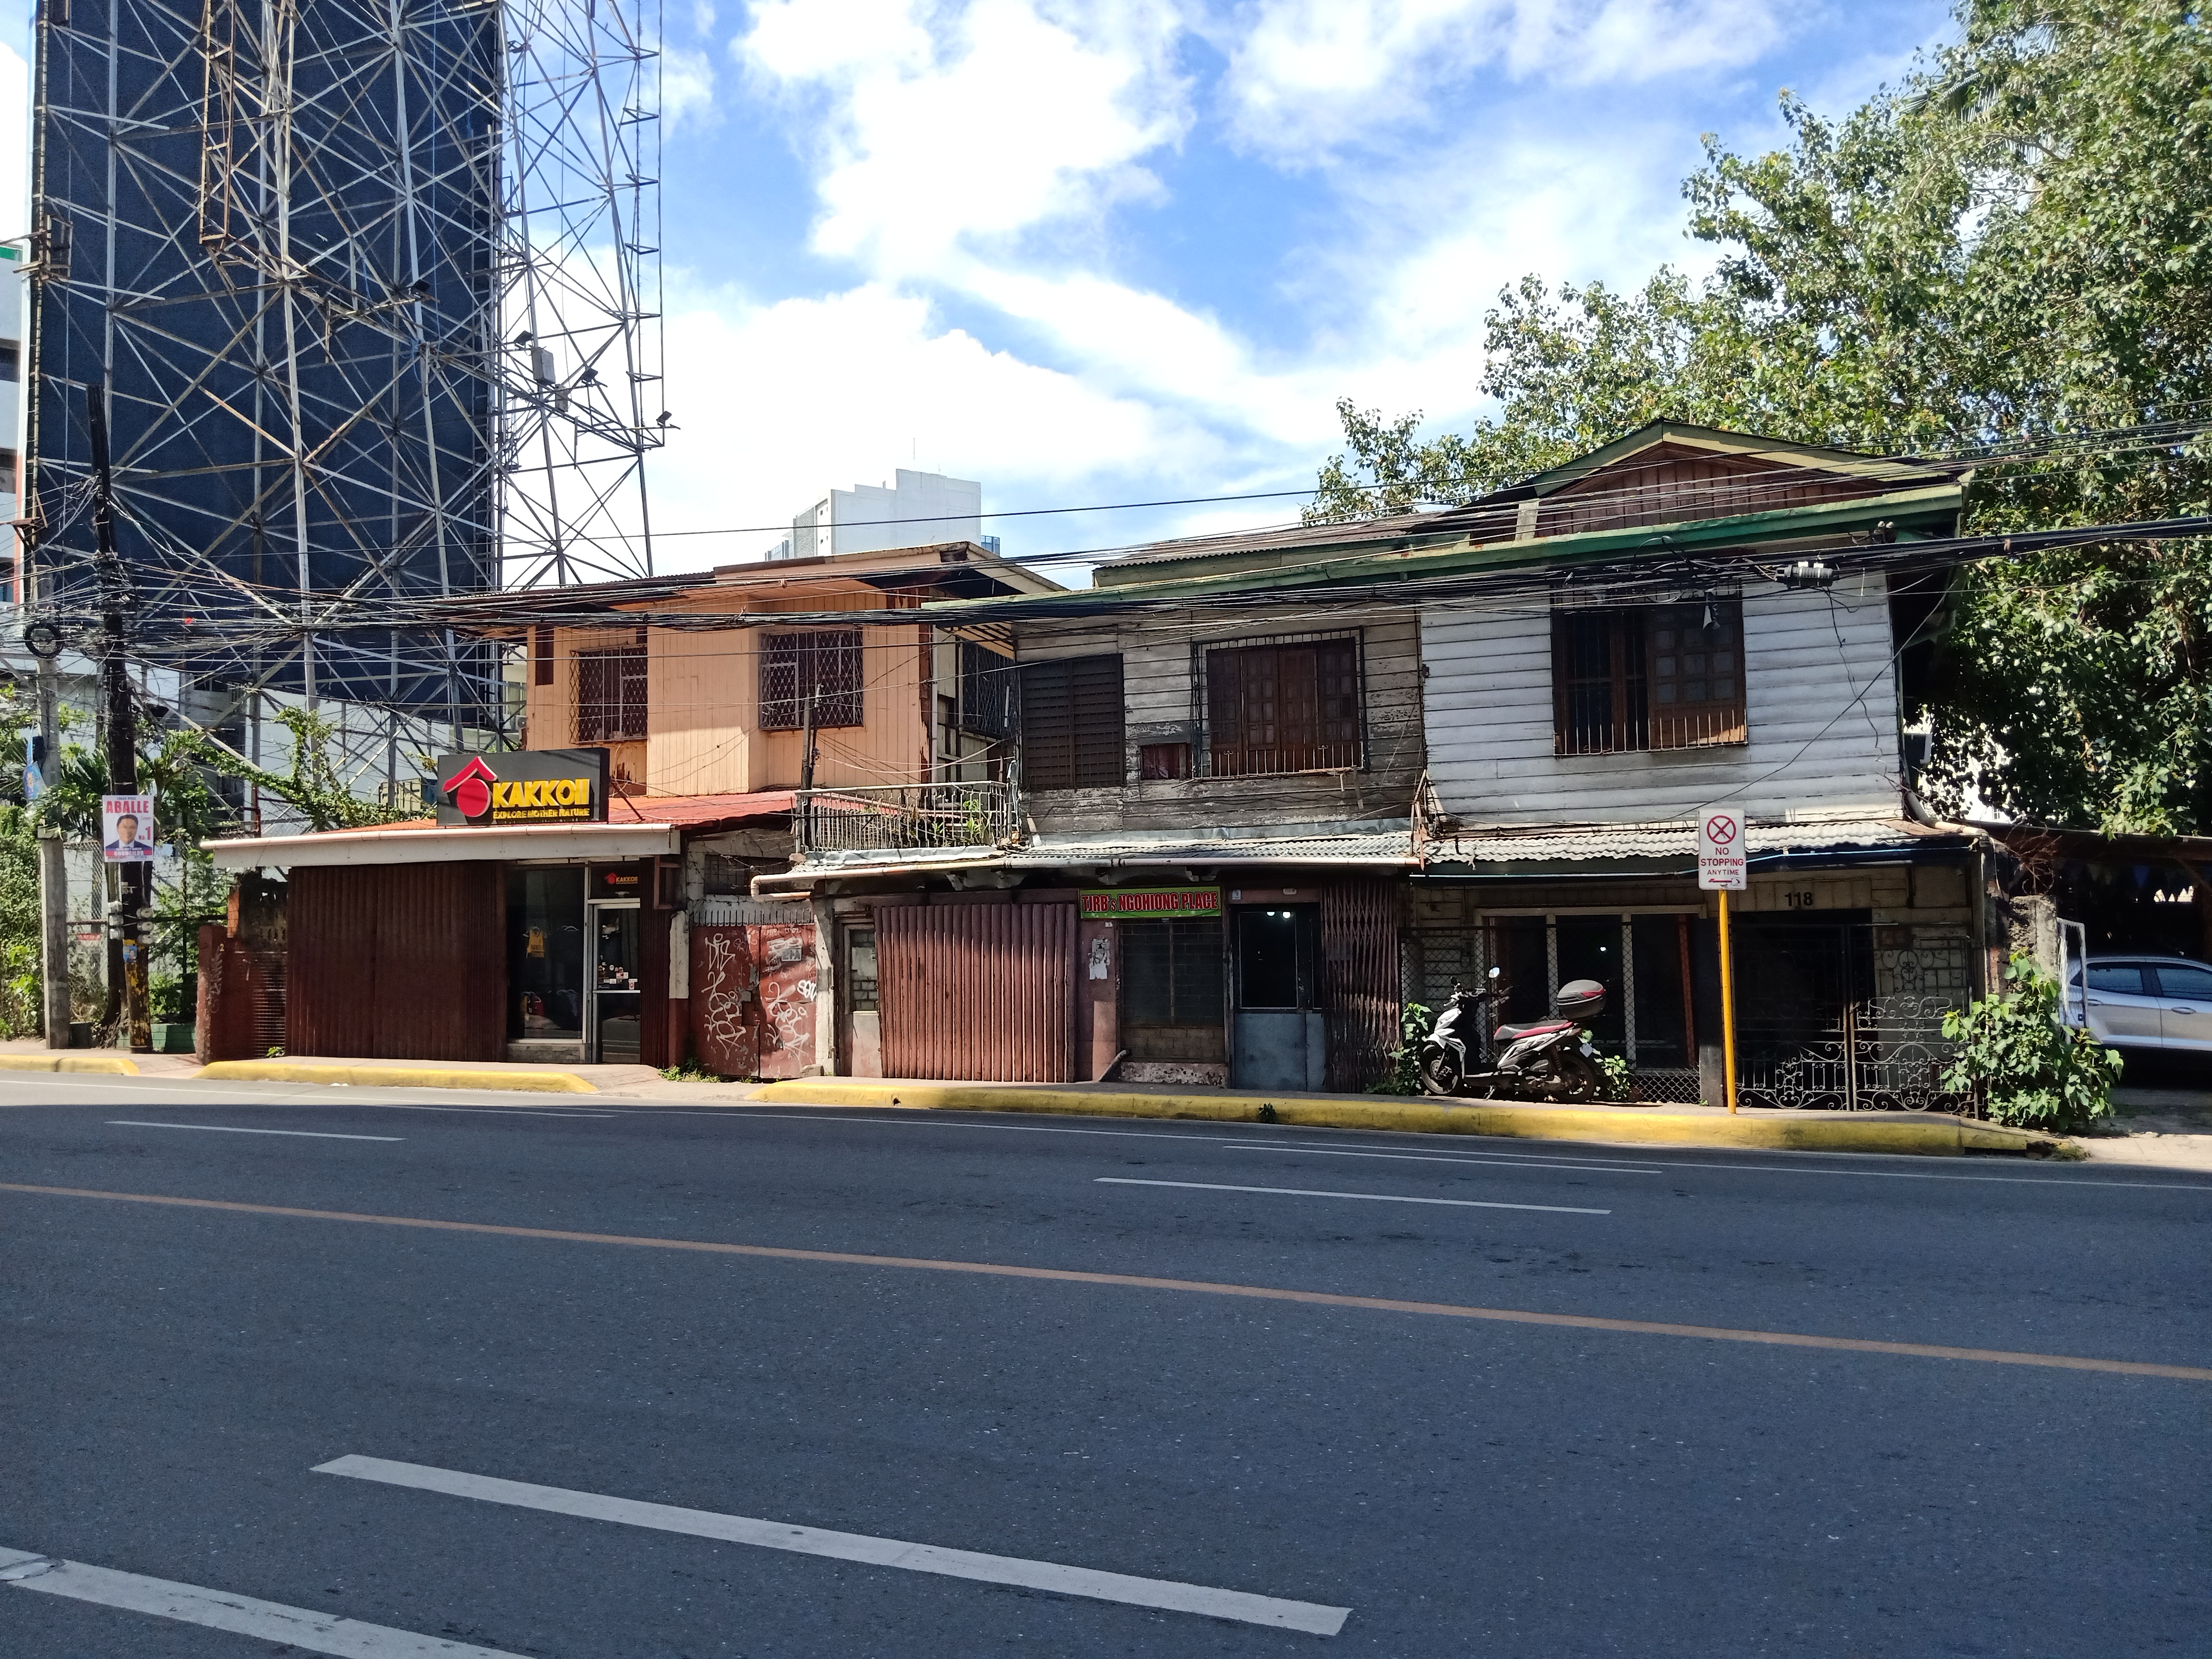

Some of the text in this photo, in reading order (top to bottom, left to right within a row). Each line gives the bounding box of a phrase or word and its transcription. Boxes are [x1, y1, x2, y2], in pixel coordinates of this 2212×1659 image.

[493, 779, 590, 808] KAKKOII
[106, 801, 149, 813] ABALLE
[493, 808, 590, 819] EXPLORE MOTHER NATURE
[145, 826, 151, 840] 1
[1118, 892, 1179, 911] NGOHIONG
[1180, 891, 1218, 910] PLACE
[1784, 891, 1813, 906] 118
[219, 943, 225, 951] 2
